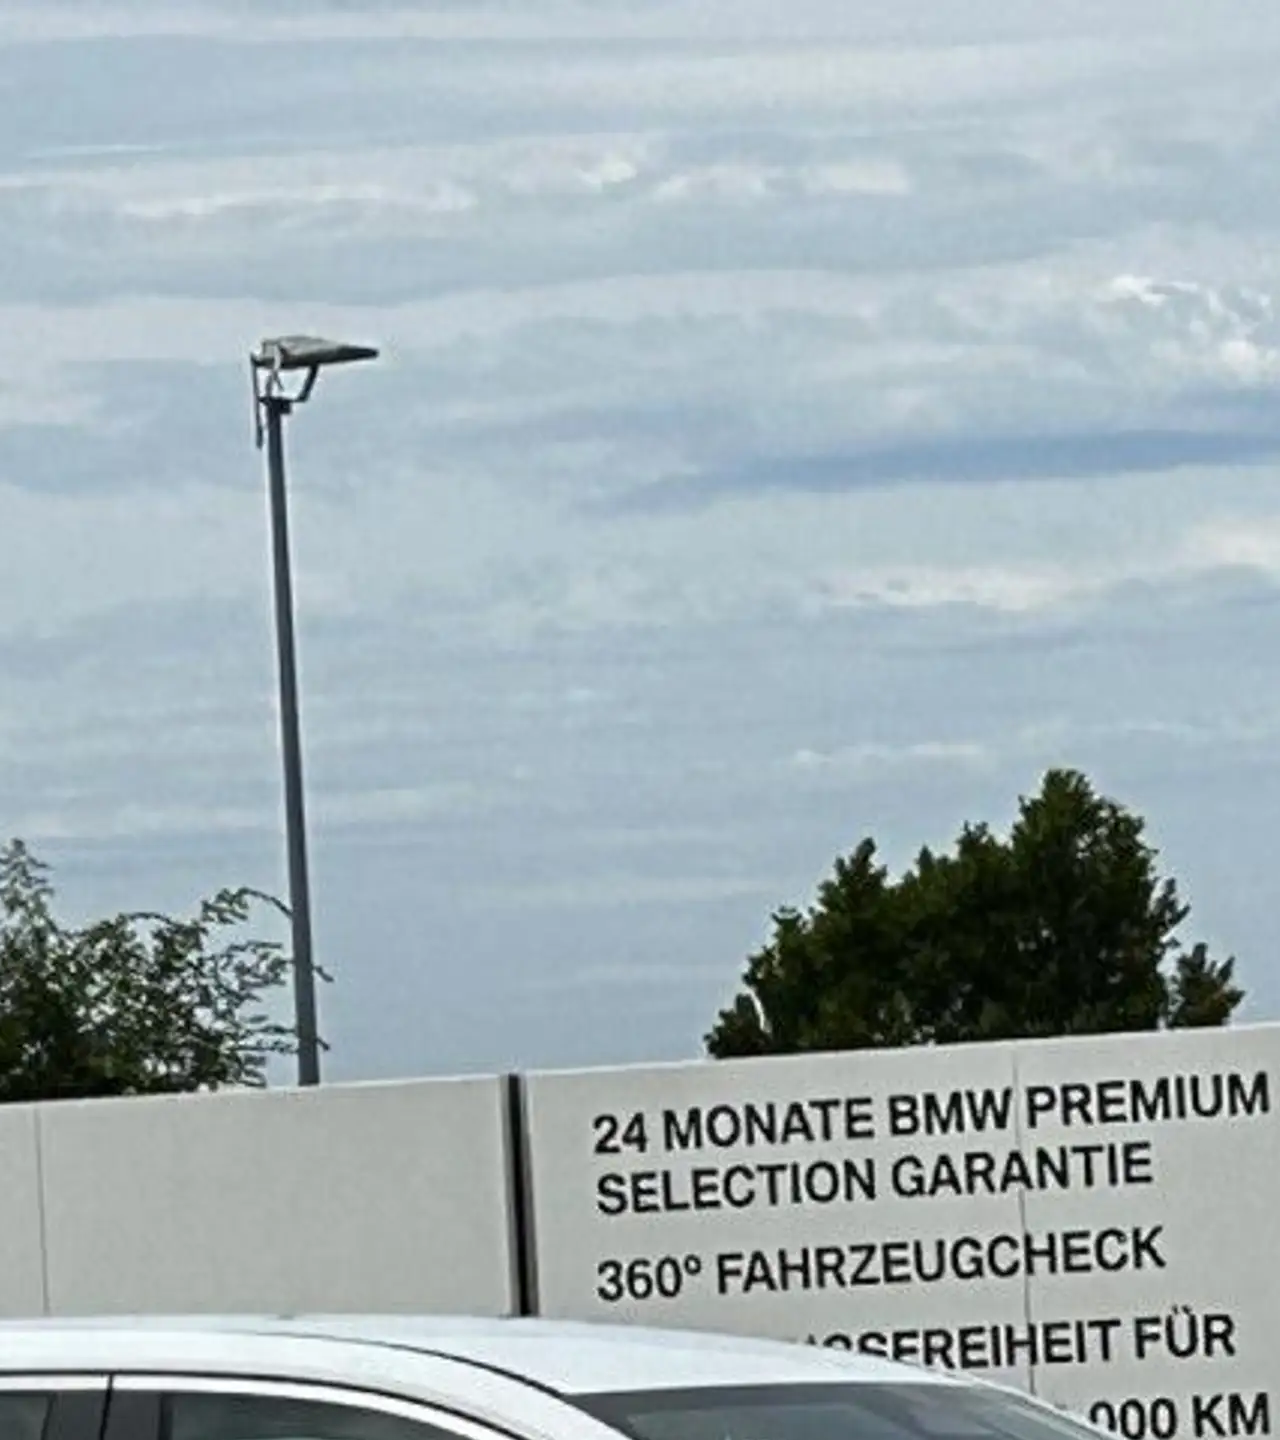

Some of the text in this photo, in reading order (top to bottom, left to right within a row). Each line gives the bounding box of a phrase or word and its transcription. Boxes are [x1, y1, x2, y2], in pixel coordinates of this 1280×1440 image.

[593, 1071, 1270, 1154] 24 MONATE BMW PREMIUM
[597, 1141, 1153, 1216] SELECTION GARANTIE
[597, 1225, 1166, 1302] 360° FAHRZEUGCHECK
[807, 1305, 1235, 1369] SFREIHEIT FÜR
[1089, 1398, 1178, 1440] 000
[1192, 1392, 1270, 1438] KM
